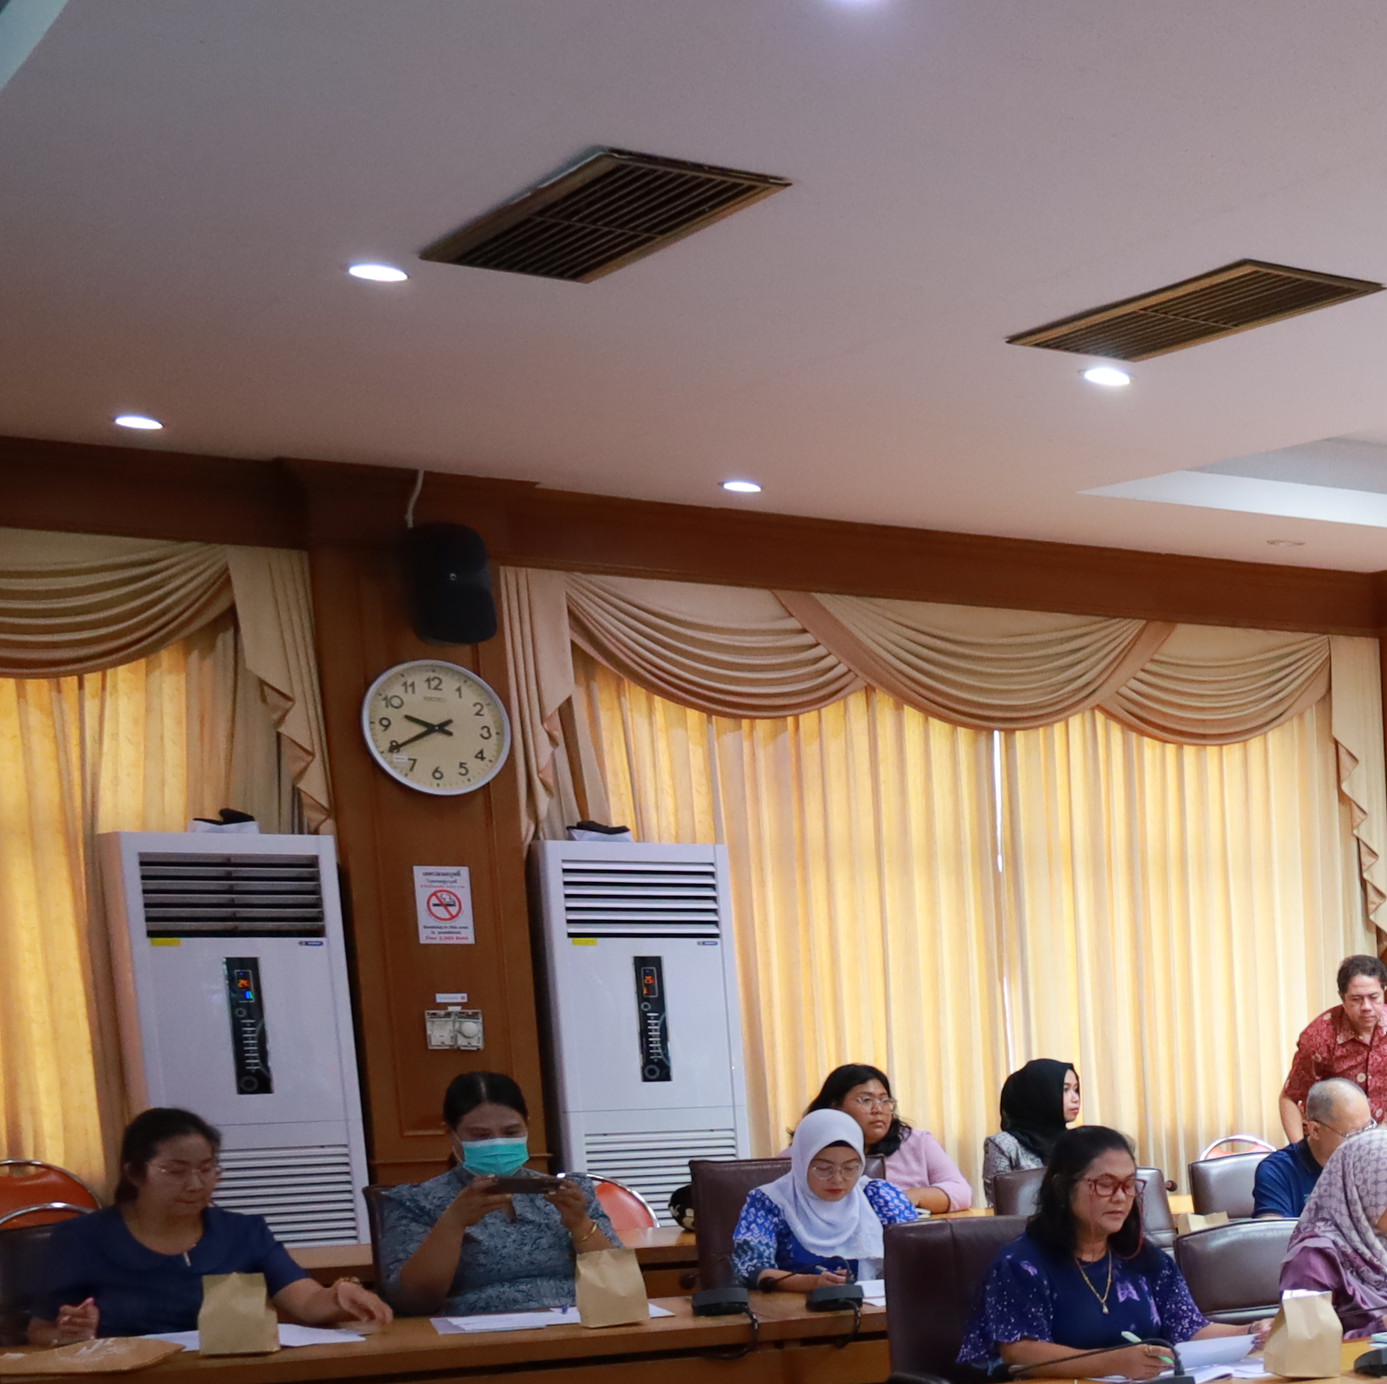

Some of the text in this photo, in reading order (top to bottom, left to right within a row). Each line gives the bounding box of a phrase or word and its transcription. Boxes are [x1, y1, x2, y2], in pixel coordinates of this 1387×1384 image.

[401, 681, 416, 695] 11
[424, 676, 443, 692] 12
[455, 685, 463, 699] 1
[382, 694, 405, 709] 10
[472, 702, 485, 717] 2
[379, 717, 392, 731] 9
[480, 725, 492, 740] 3
[474, 749, 486, 762] 4
[408, 758, 418, 772] 7
[458, 762, 469, 776] 5
[432, 766, 444, 780] 6
